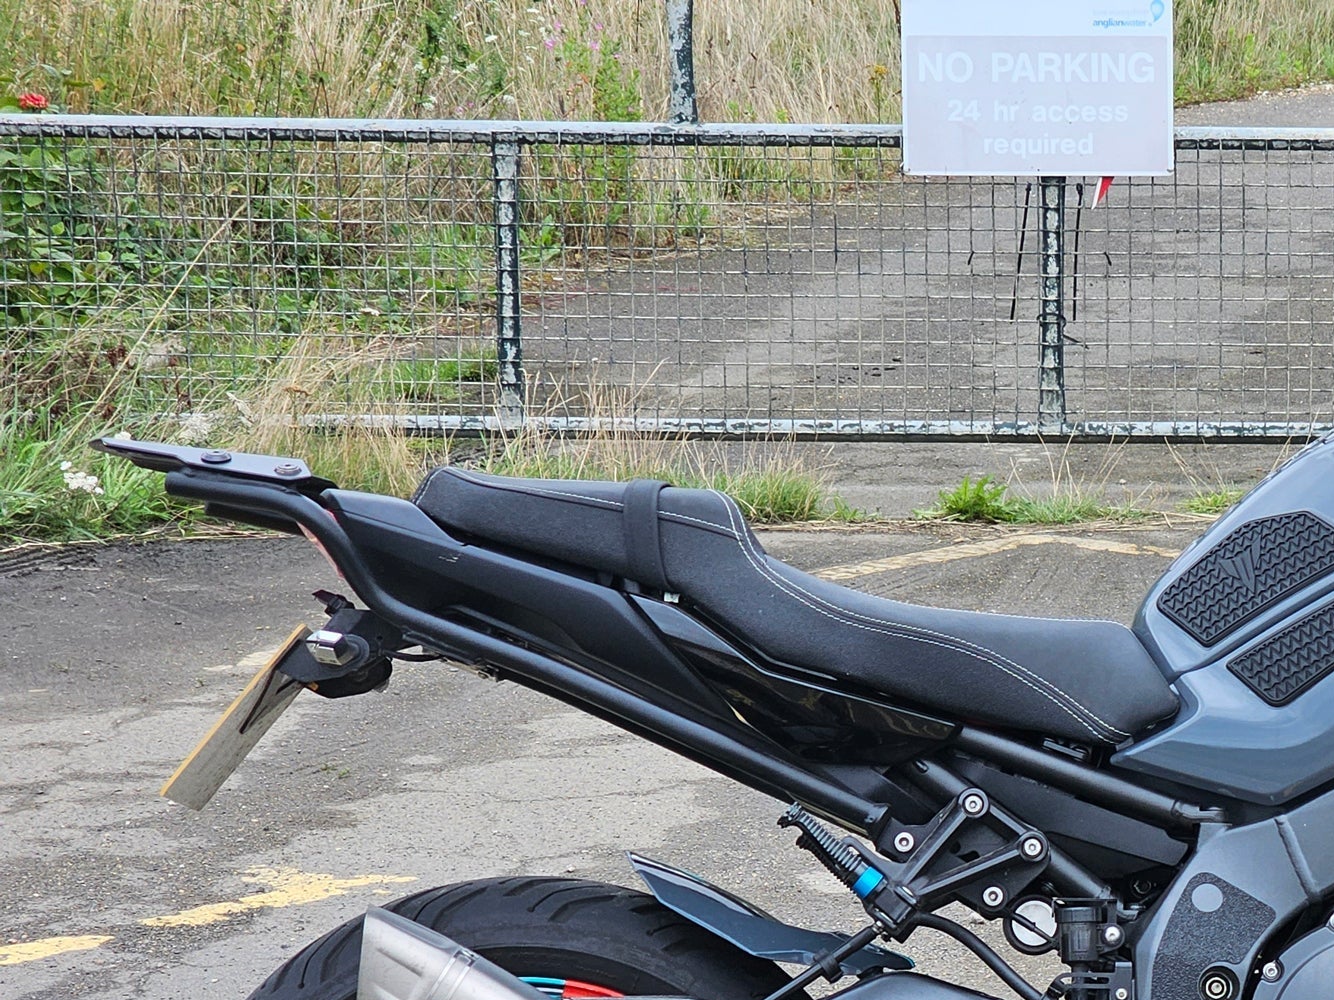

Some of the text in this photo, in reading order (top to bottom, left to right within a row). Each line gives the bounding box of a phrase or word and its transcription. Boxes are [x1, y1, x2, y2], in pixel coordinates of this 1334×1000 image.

[917, 51, 1156, 83] NO PARKING
[947, 100, 1129, 123] 24 hr access
[983, 133, 1094, 159] required
